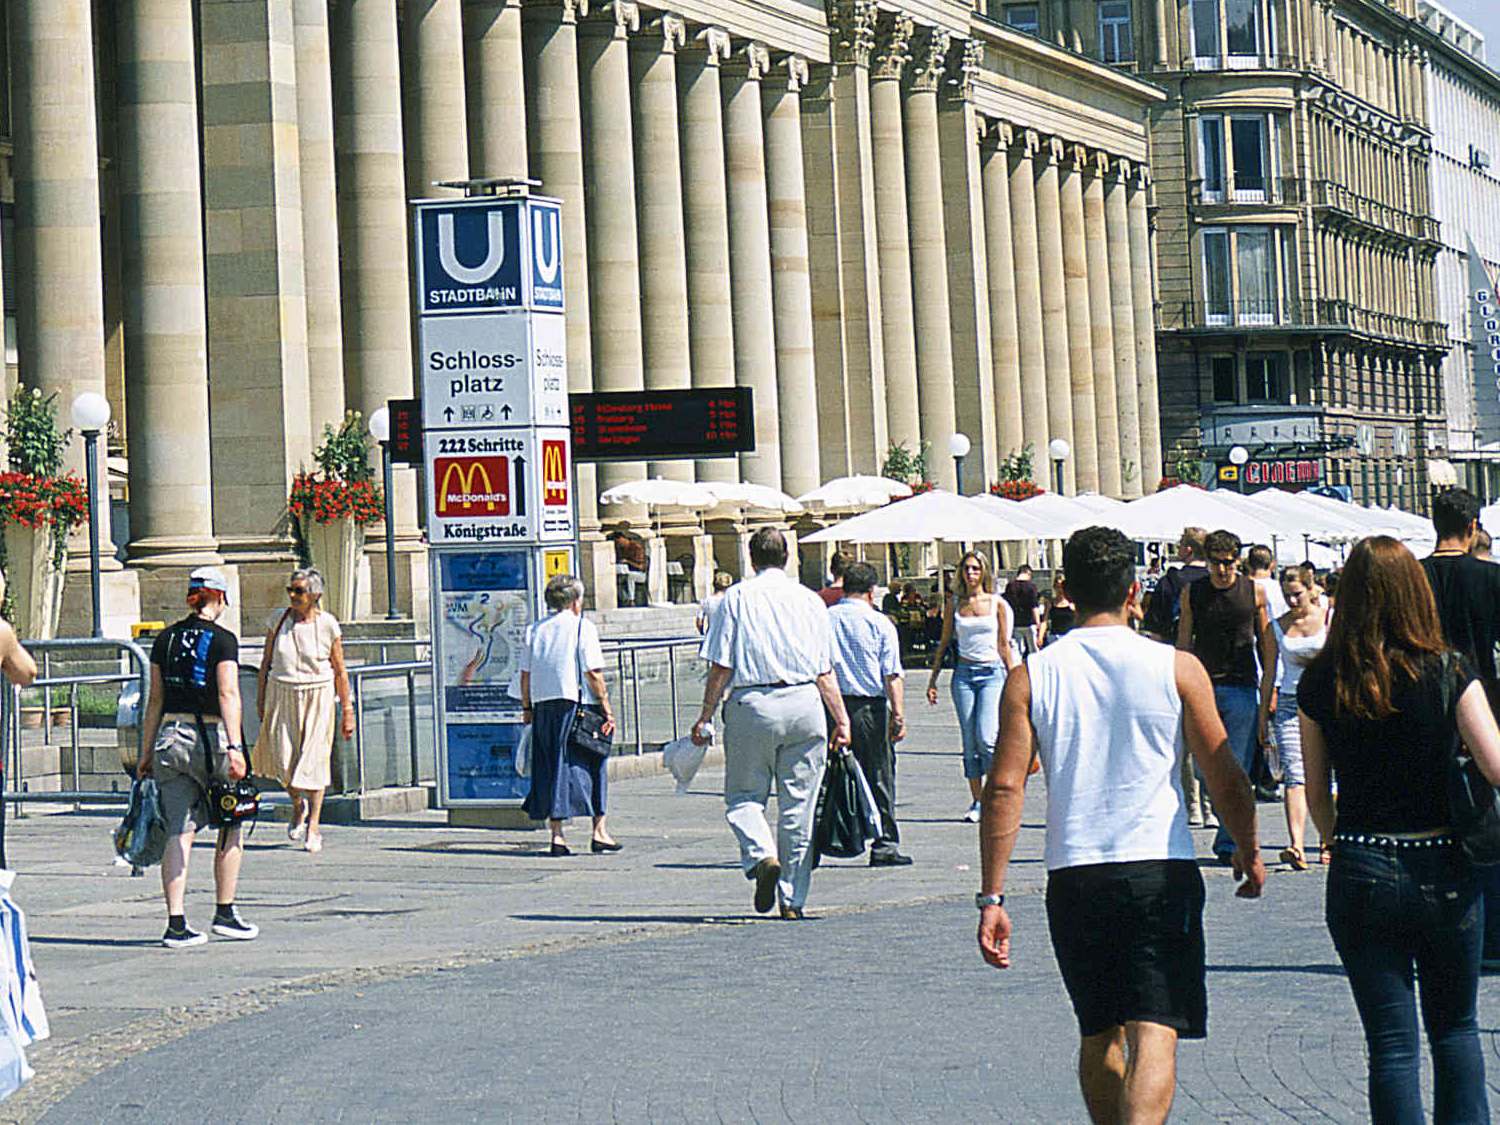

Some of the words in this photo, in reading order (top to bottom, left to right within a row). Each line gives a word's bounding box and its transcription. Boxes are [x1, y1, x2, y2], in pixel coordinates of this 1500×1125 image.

[438, 211, 505, 284] U
[533, 209, 558, 284] U
[430, 286, 517, 304] STADTBAHN
[429, 350, 523, 371] Schloss-
[451, 374, 504, 397] platz
[439, 438, 467, 453] 222
[468, 437, 525, 452] Schritte
[447, 493, 507, 503] McDonald's
[443, 522, 528, 541] Königstraße
